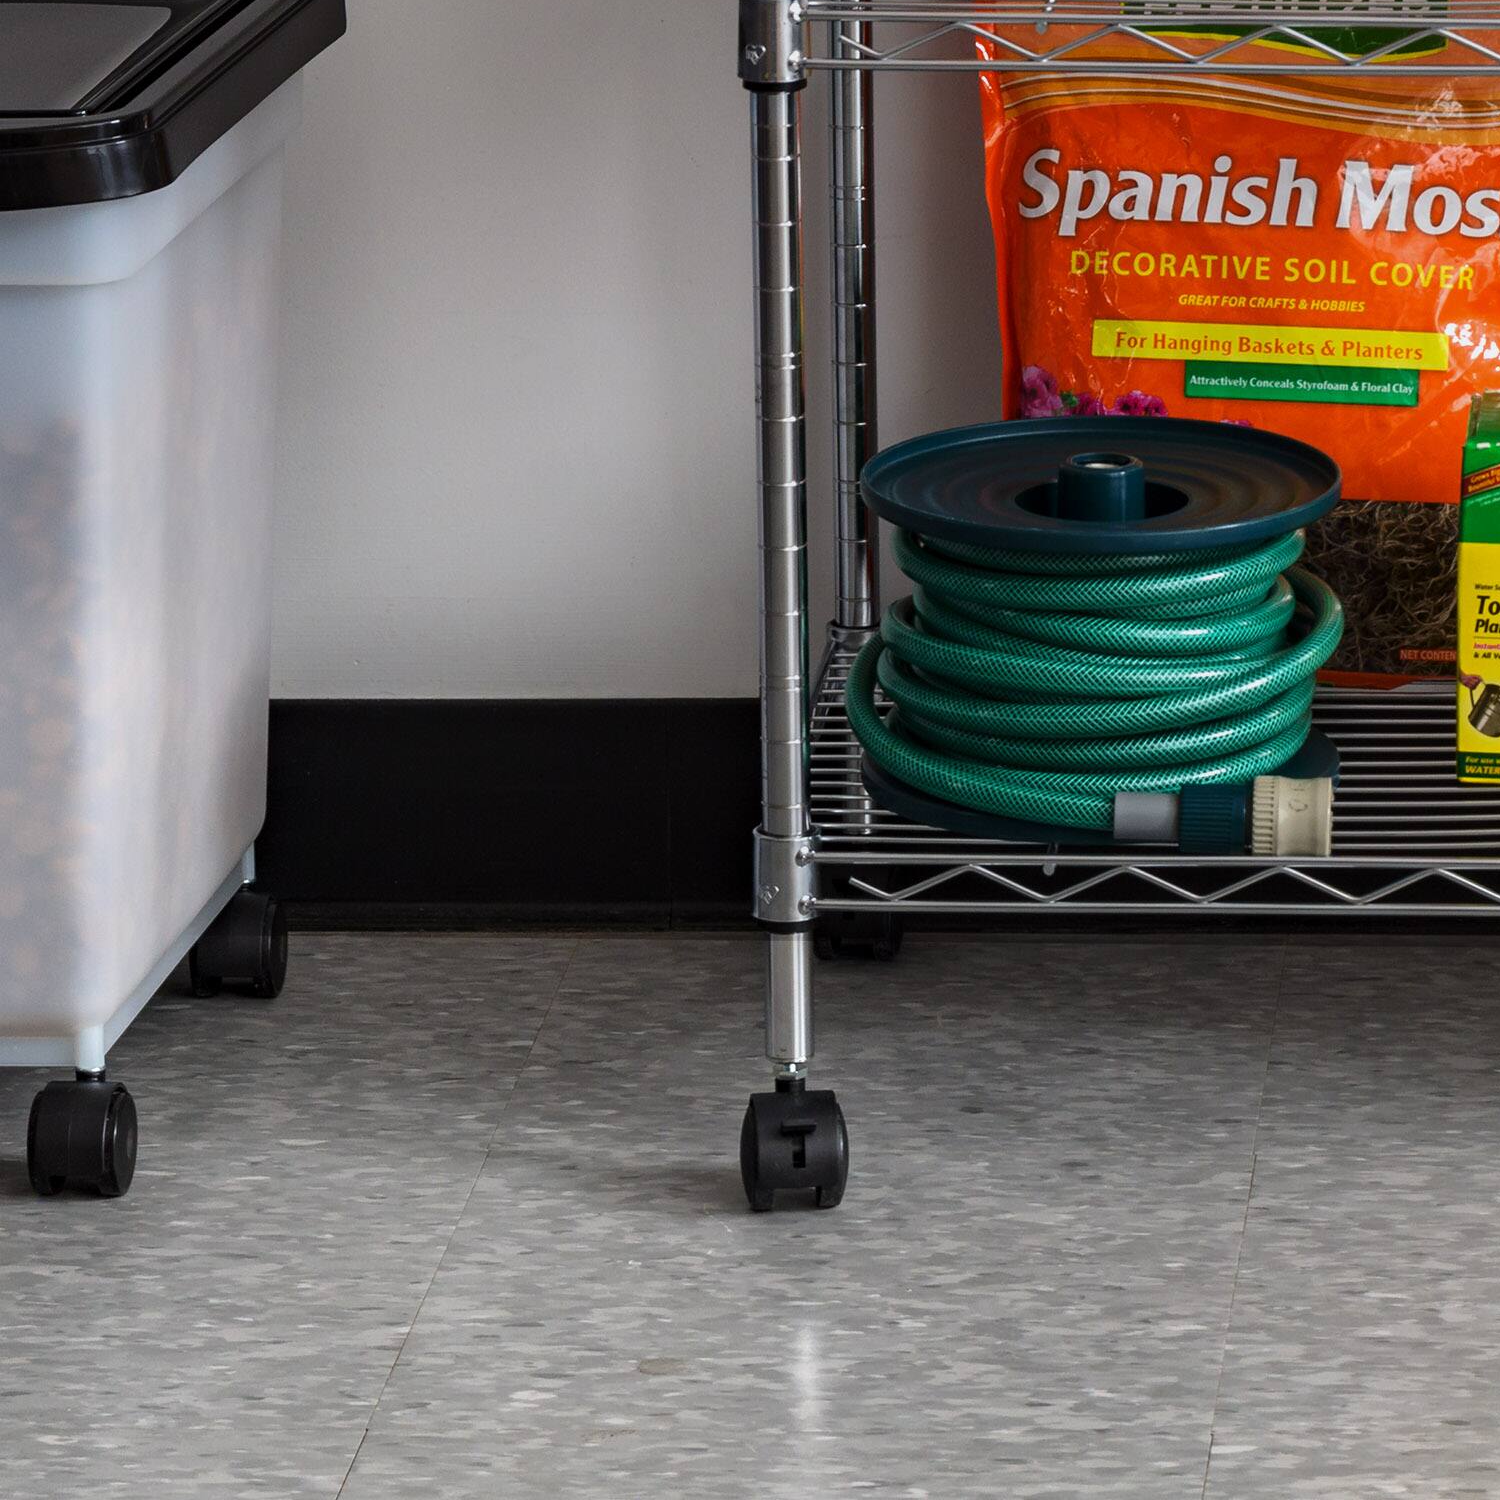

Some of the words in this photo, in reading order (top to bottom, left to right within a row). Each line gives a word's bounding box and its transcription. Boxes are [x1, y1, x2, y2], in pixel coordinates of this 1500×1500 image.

[1018, 148, 1318, 237] Spanish
[1070, 249, 1271, 281] DECORATIVE
[1284, 257, 1357, 285] SOIL
[1369, 261, 1475, 290] COVER
[1178, 293, 1219, 306] GREAT
[1220, 295, 1247, 308] FOR
[1249, 297, 1296, 310] CRAFTS
[1298, 299, 1307, 310] &
[1310, 300, 1366, 313] HOBBIES
[1115, 331, 1147, 349] For
[1153, 332, 1233, 356] Hanging
[1238, 335, 1315, 357] Baskets
[1321, 339, 1336, 357] &
[1342, 340, 1423, 361] Planters
[1189, 374, 1248, 389] Attractively
[1249, 376, 1295, 389] Conceals
[1296, 378, 1349, 392] Styrofoam
[1350, 381, 1359, 392] &
[1361, 381, 1391, 393] Floral
[1391, 382, 1414, 395] Clay
[1474, 583, 1494, 591] Water
[1400, 649, 1419, 660] NET
[1420, 650, 1457, 661] CONTEN
[1465, 755, 1479, 764] For
[1480, 757, 1494, 765] use
